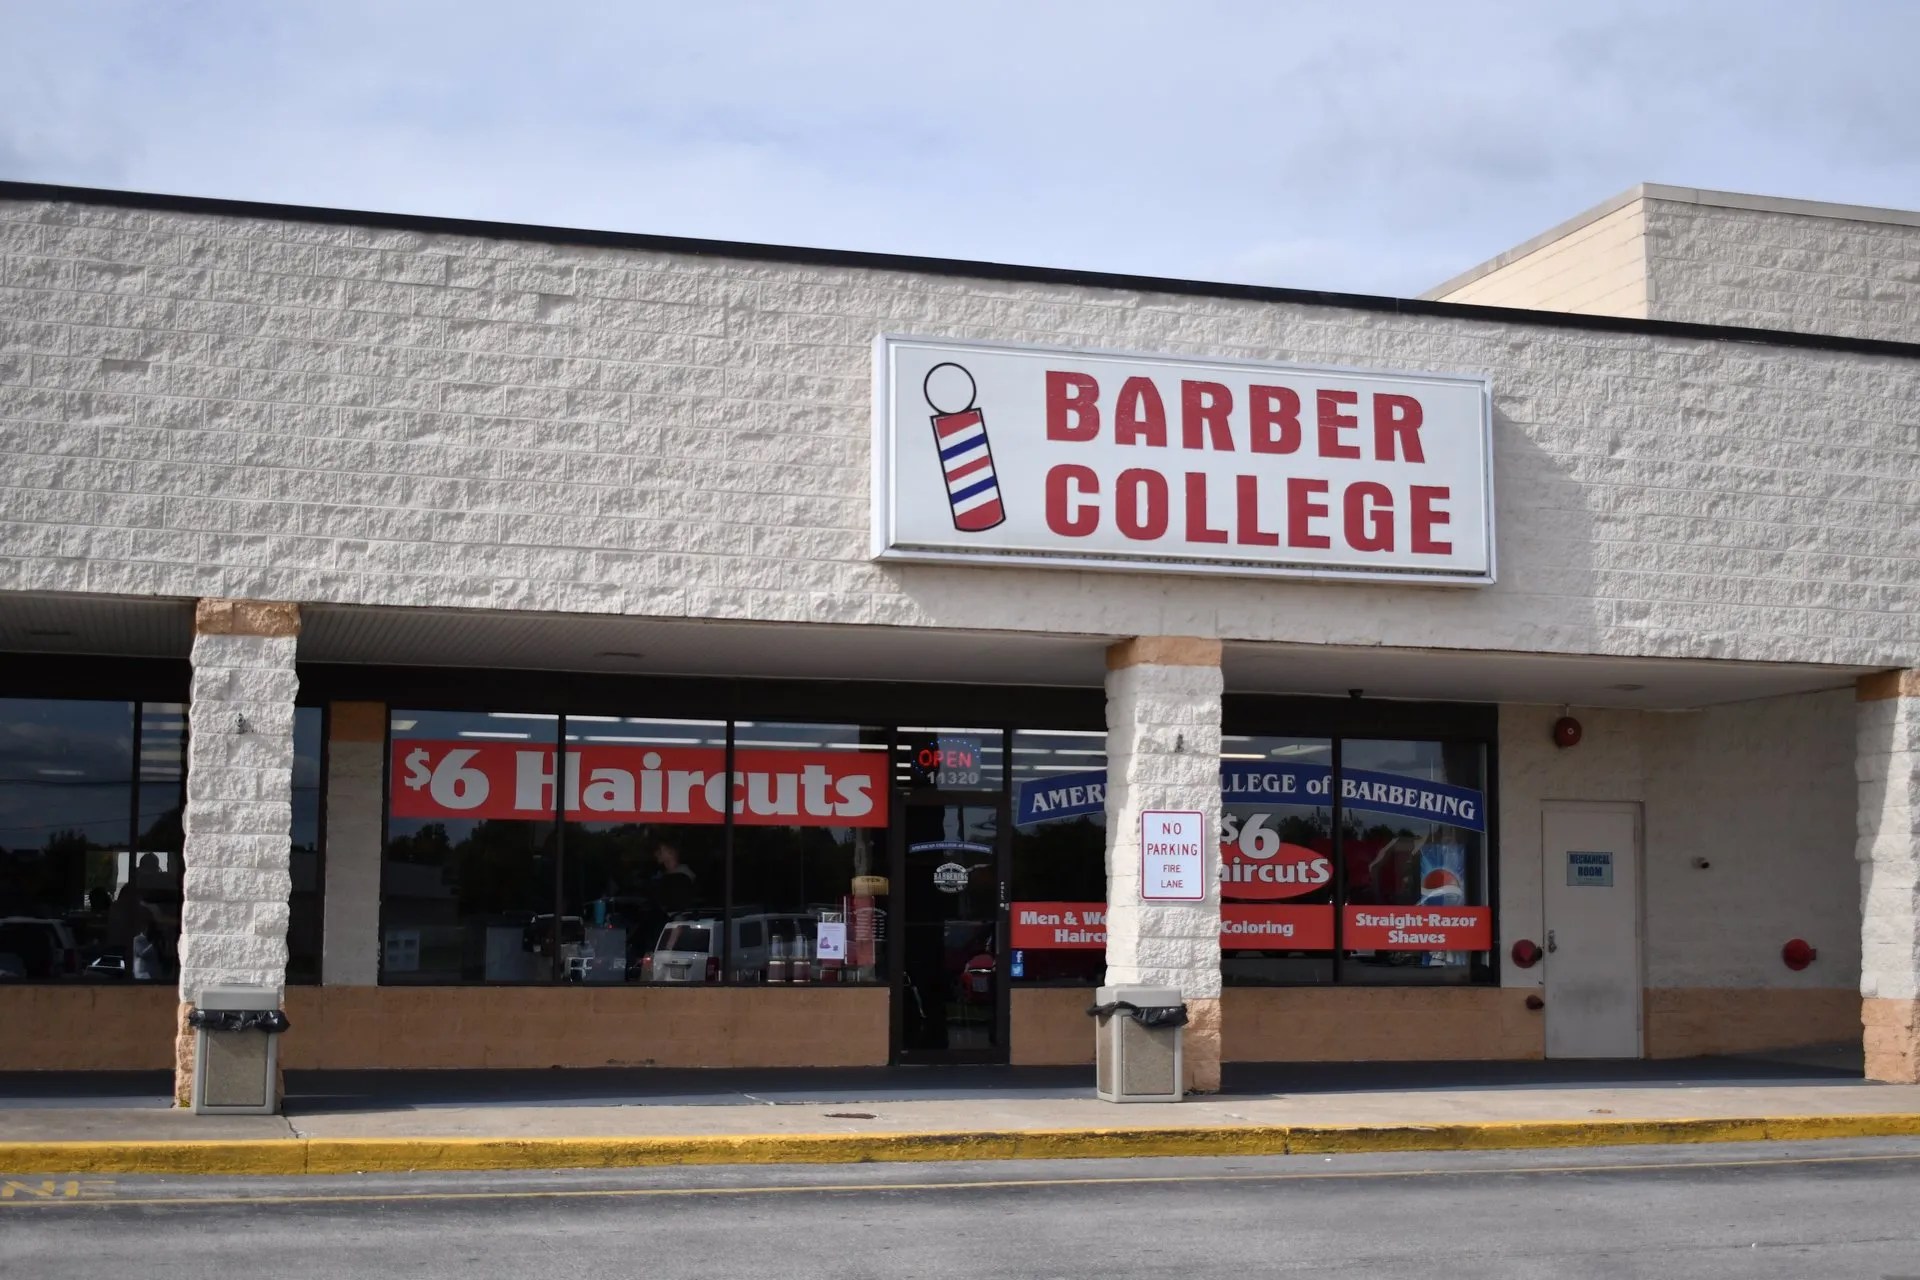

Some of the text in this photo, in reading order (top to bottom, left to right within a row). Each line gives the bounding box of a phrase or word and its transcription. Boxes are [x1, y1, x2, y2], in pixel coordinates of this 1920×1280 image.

[1045, 369, 1426, 463] BARBER
[1044, 463, 1452, 555] COLLEGE
[918, 749, 973, 768] OPEN
[404, 748, 874, 817] $6 Haircuts
[1306, 775, 1332, 795] of
[1341, 779, 1476, 820] BARBERING
[1162, 822, 1182, 835] NO
[1147, 843, 1198, 856] PARKING
[1569, 854, 1610, 865] MECHANICAL
[1163, 864, 1181, 873] FIRE
[1578, 866, 1602, 877] ROOM
[1160, 879, 1184, 889] LANE
[1020, 911, 1060, 925] Men
[1063, 911, 1078, 925] &
[1355, 912, 1478, 929] Straight-Razor
[1220, 920, 1294, 937] Coloring
[1388, 930, 1446, 944] Shaves
